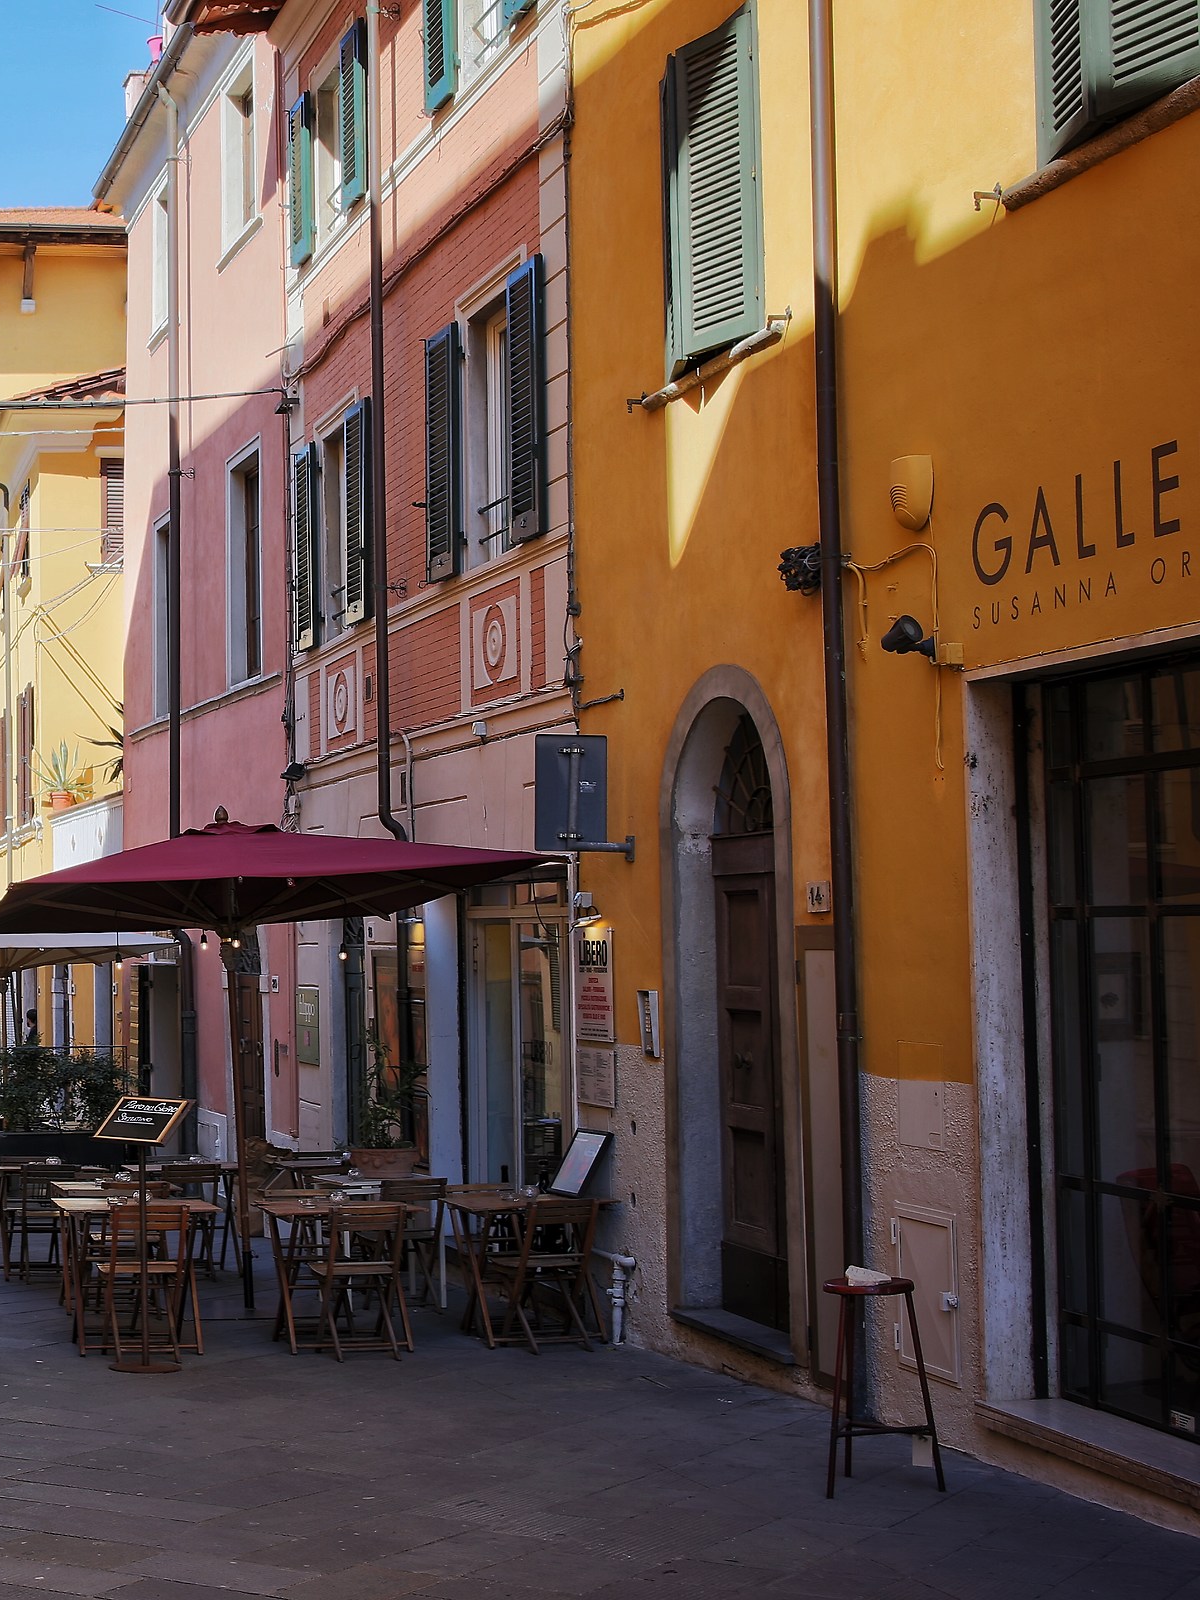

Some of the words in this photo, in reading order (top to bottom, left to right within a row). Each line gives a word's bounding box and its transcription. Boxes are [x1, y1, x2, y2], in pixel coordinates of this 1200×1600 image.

[972, 439, 1181, 586] GALLE
[972, 571, 1117, 630] SUSANNA
[1150, 551, 1191, 585] OR
[809, 886, 823, 906] 14
